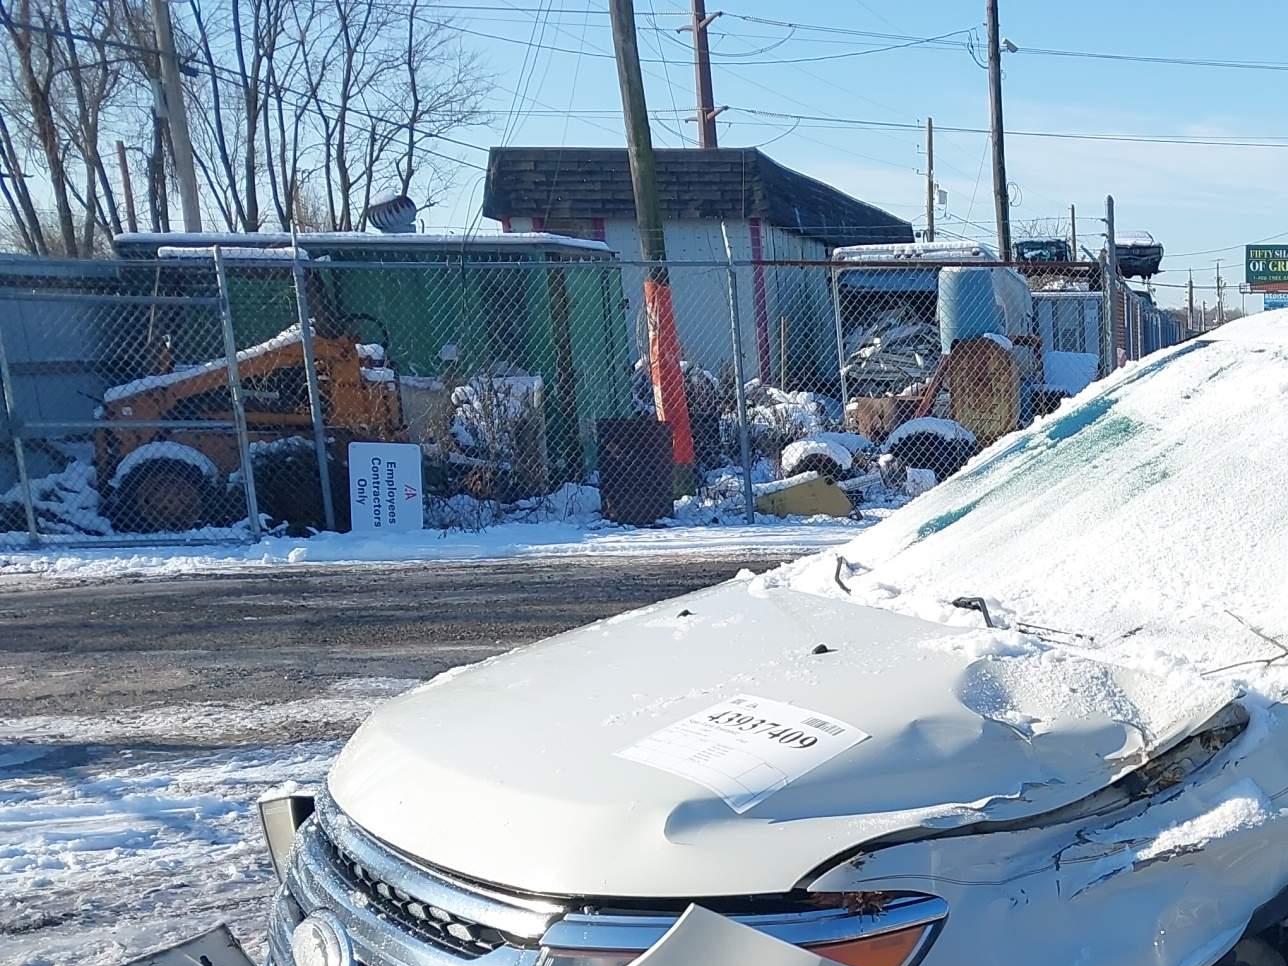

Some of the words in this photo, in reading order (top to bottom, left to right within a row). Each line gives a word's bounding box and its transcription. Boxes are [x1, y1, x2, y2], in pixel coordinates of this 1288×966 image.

[1249, 249, 1273, 258] FIFTY
[1249, 260, 1267, 272] OF
[355, 478, 368, 505] Only
[371, 457, 382, 528] Contractors
[384, 461, 397, 525] Employees
[707, 710, 818, 749] 43937409
